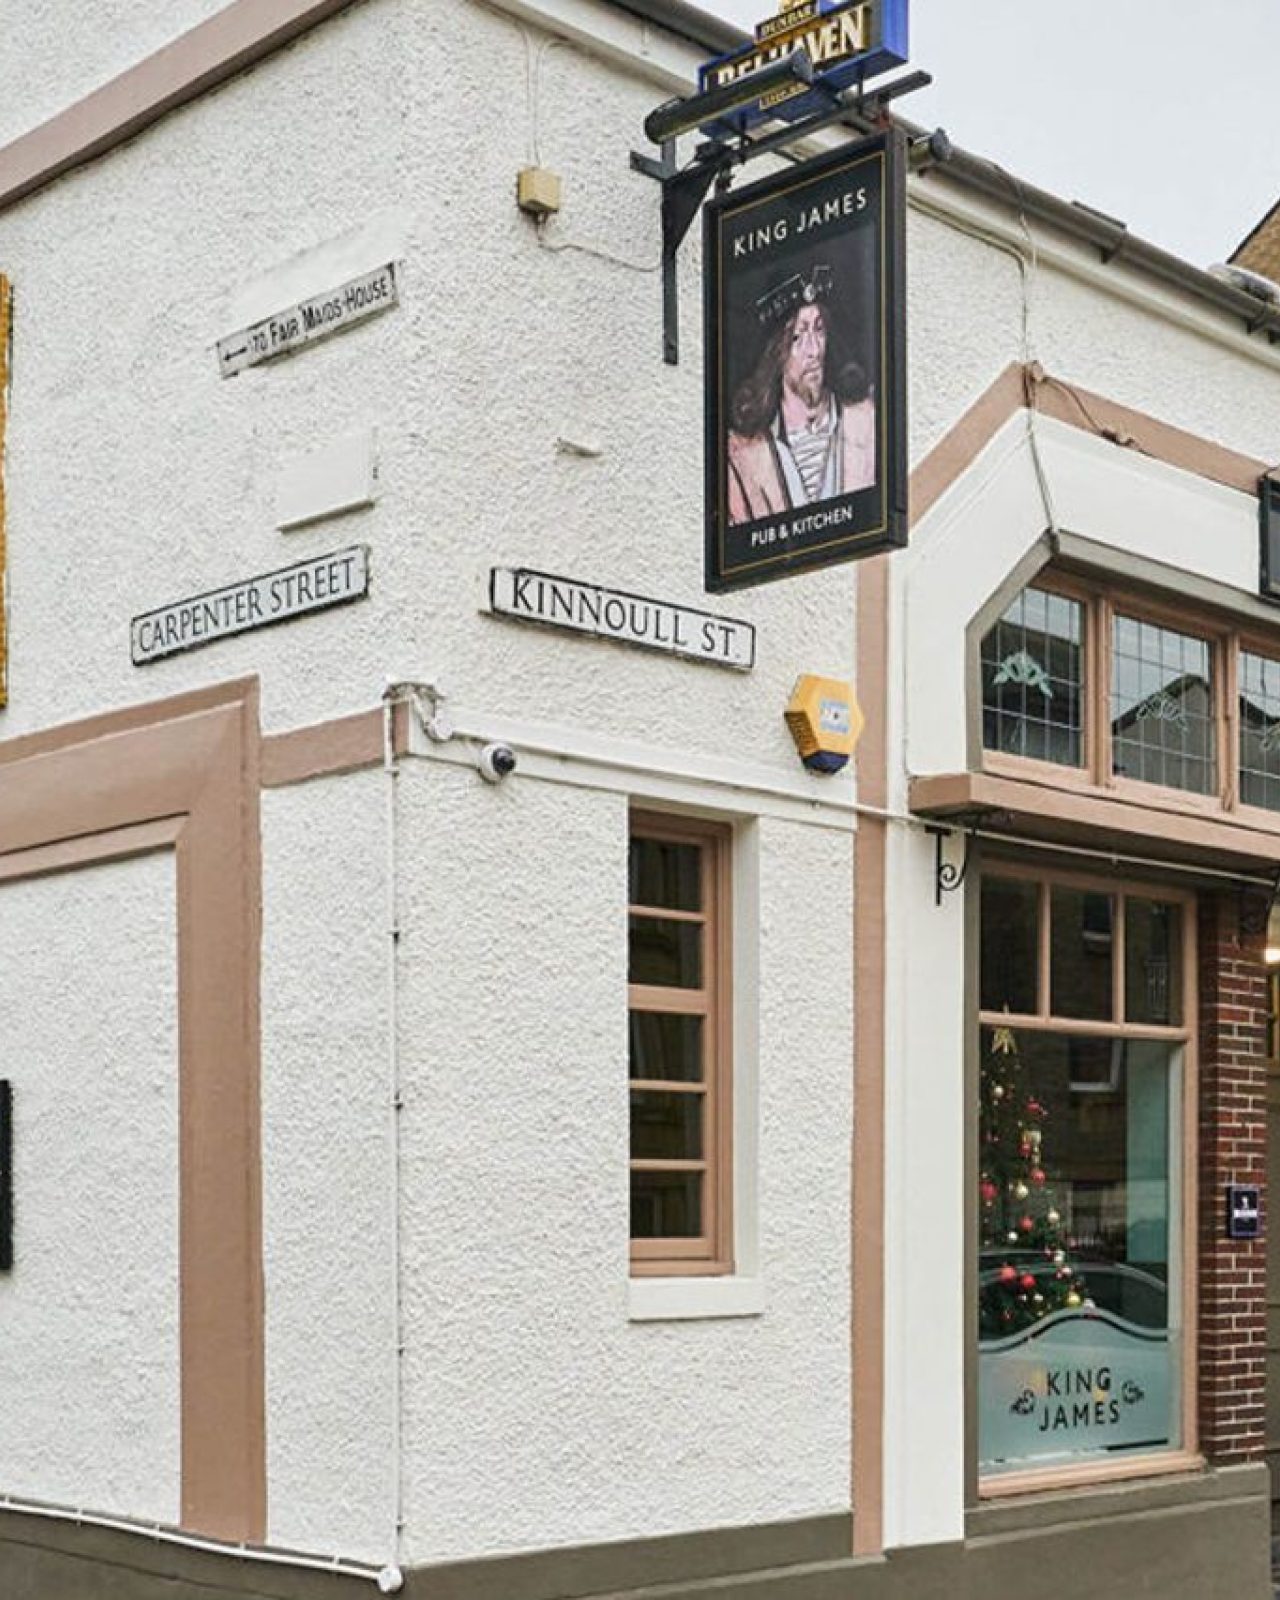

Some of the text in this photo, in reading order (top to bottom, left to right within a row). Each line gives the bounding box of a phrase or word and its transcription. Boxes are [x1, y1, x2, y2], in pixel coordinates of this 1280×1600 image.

[733, 187, 867, 257] KING JAMES
[751, 505, 853, 547] PUB & KITCHEN
[138, 556, 355, 652] CARPENTER STREET
[512, 570, 687, 646] KINNOULL
[1047, 1366, 1111, 1396] KING
[1039, 1400, 1120, 1432] JAMES
